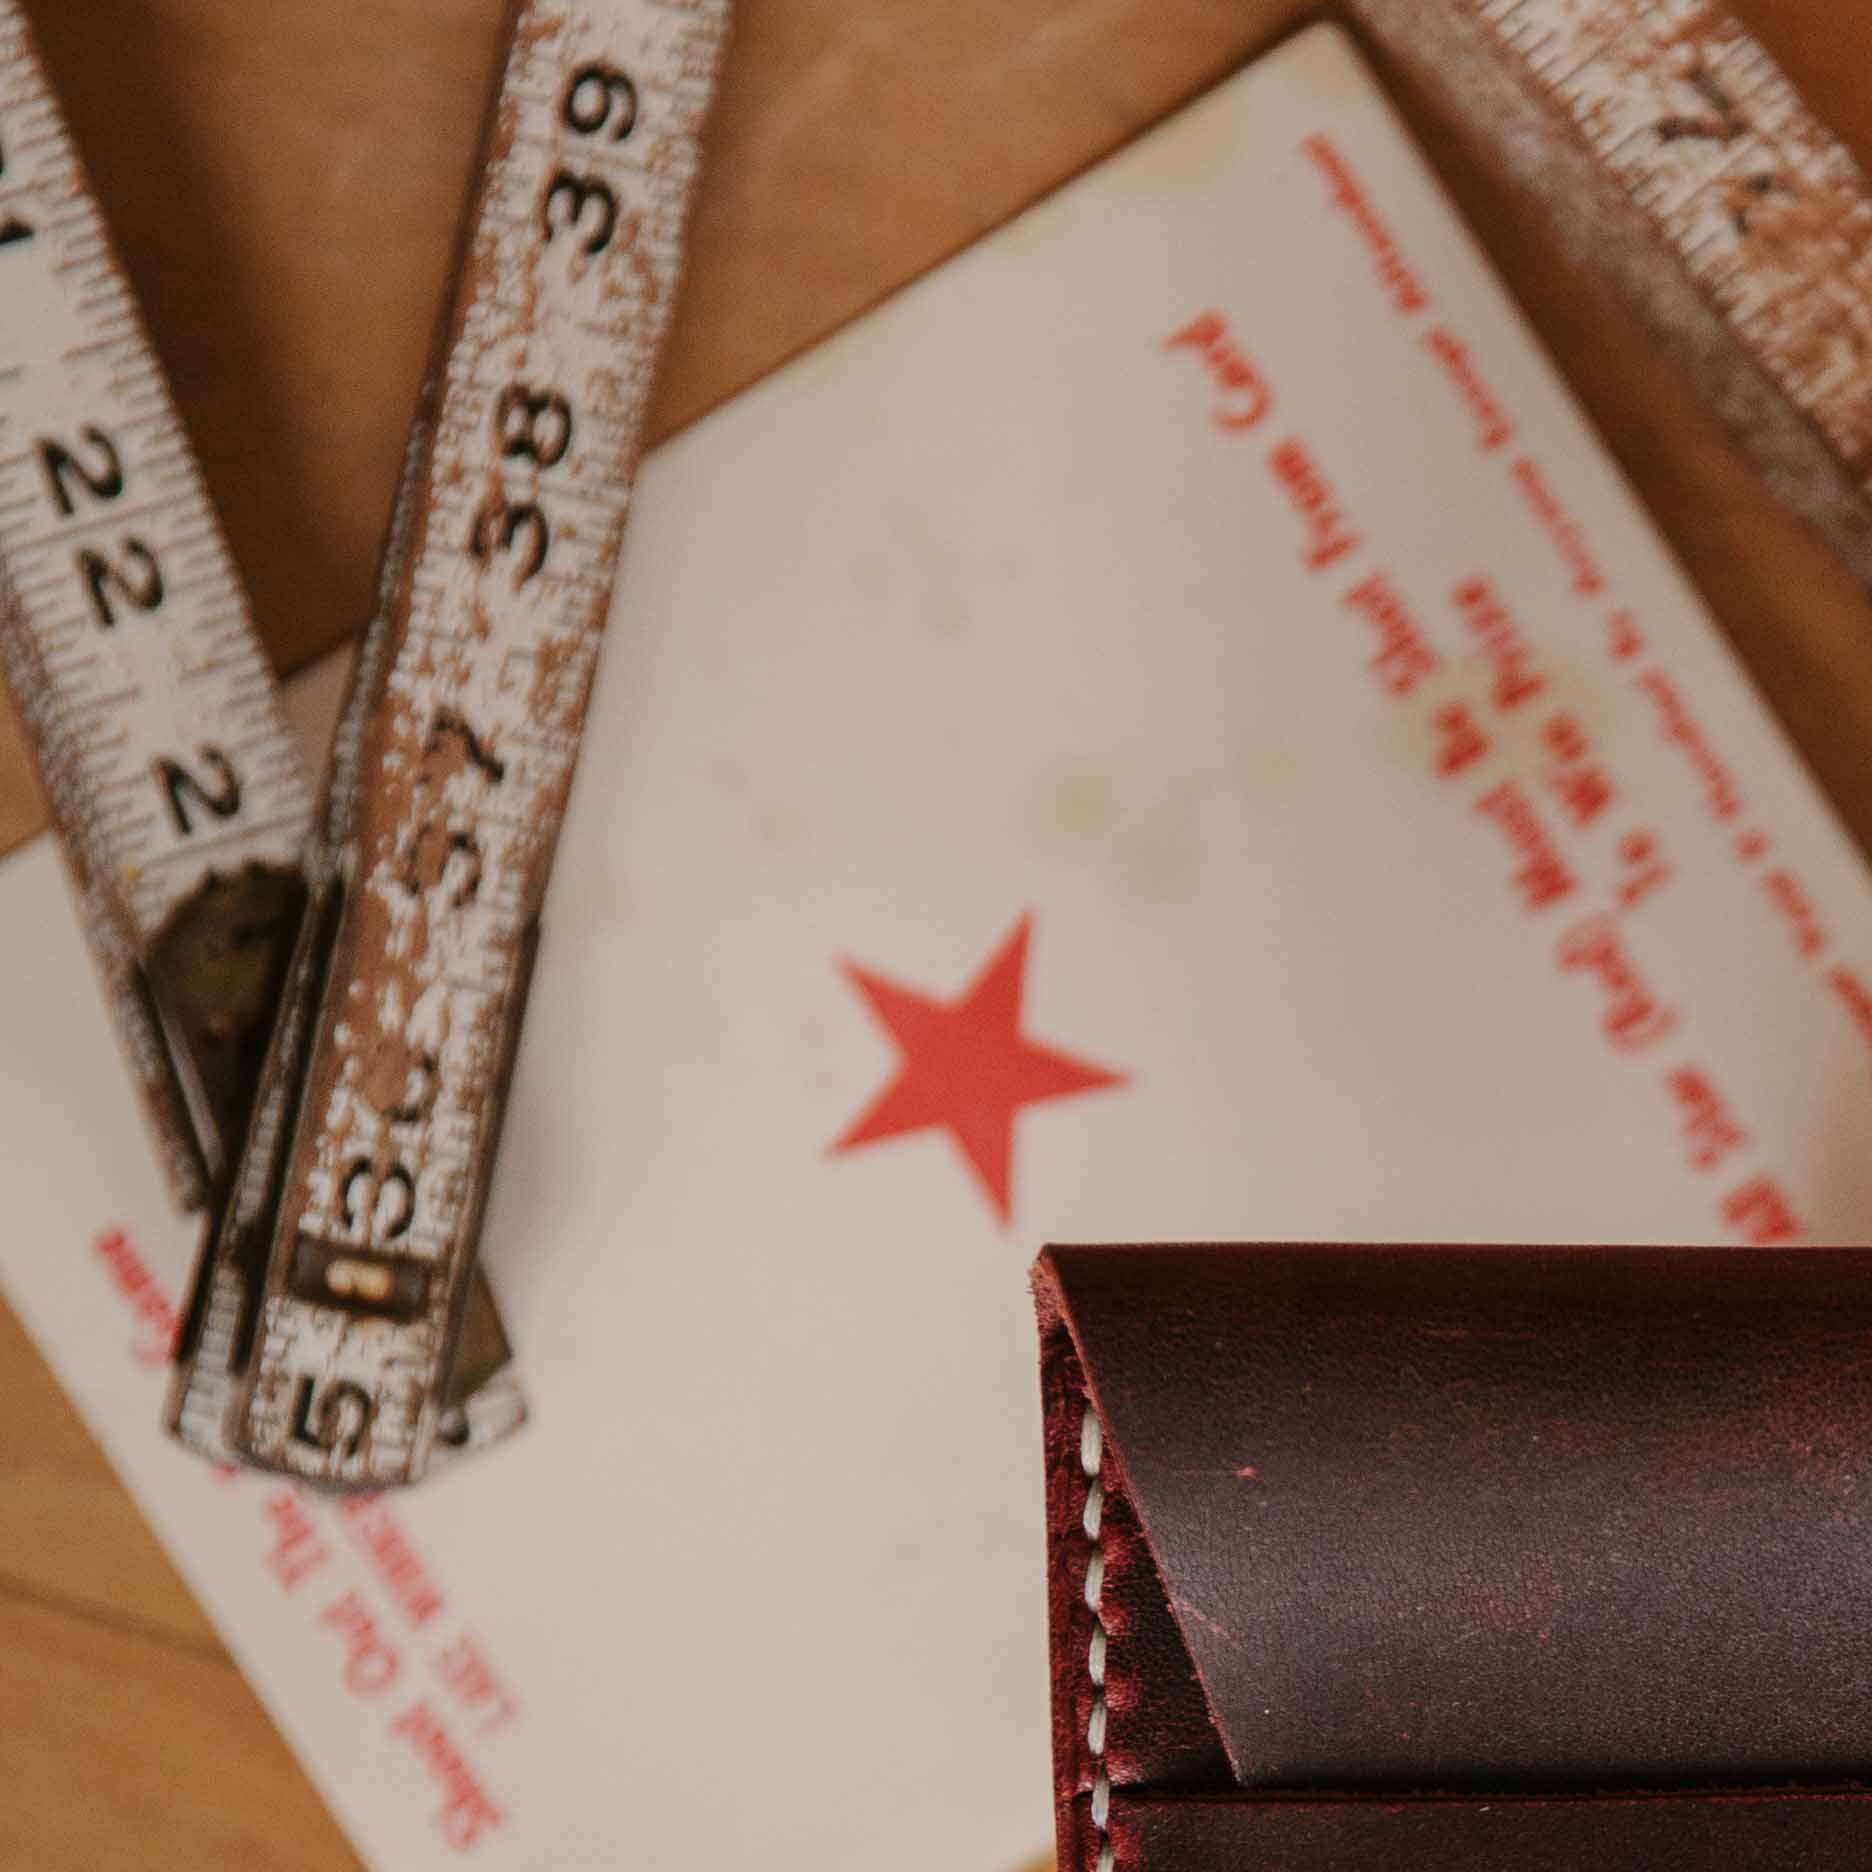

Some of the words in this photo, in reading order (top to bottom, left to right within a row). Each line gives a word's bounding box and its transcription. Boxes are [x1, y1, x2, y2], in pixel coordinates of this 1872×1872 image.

[543, 63, 638, 255] 39
[1168, 314, 1271, 432] Card
[34, 425, 165, 628] 22
[470, 385, 574, 595] 38
[1269, 441, 1358, 570] From
[1455, 578, 1548, 713] Prize
